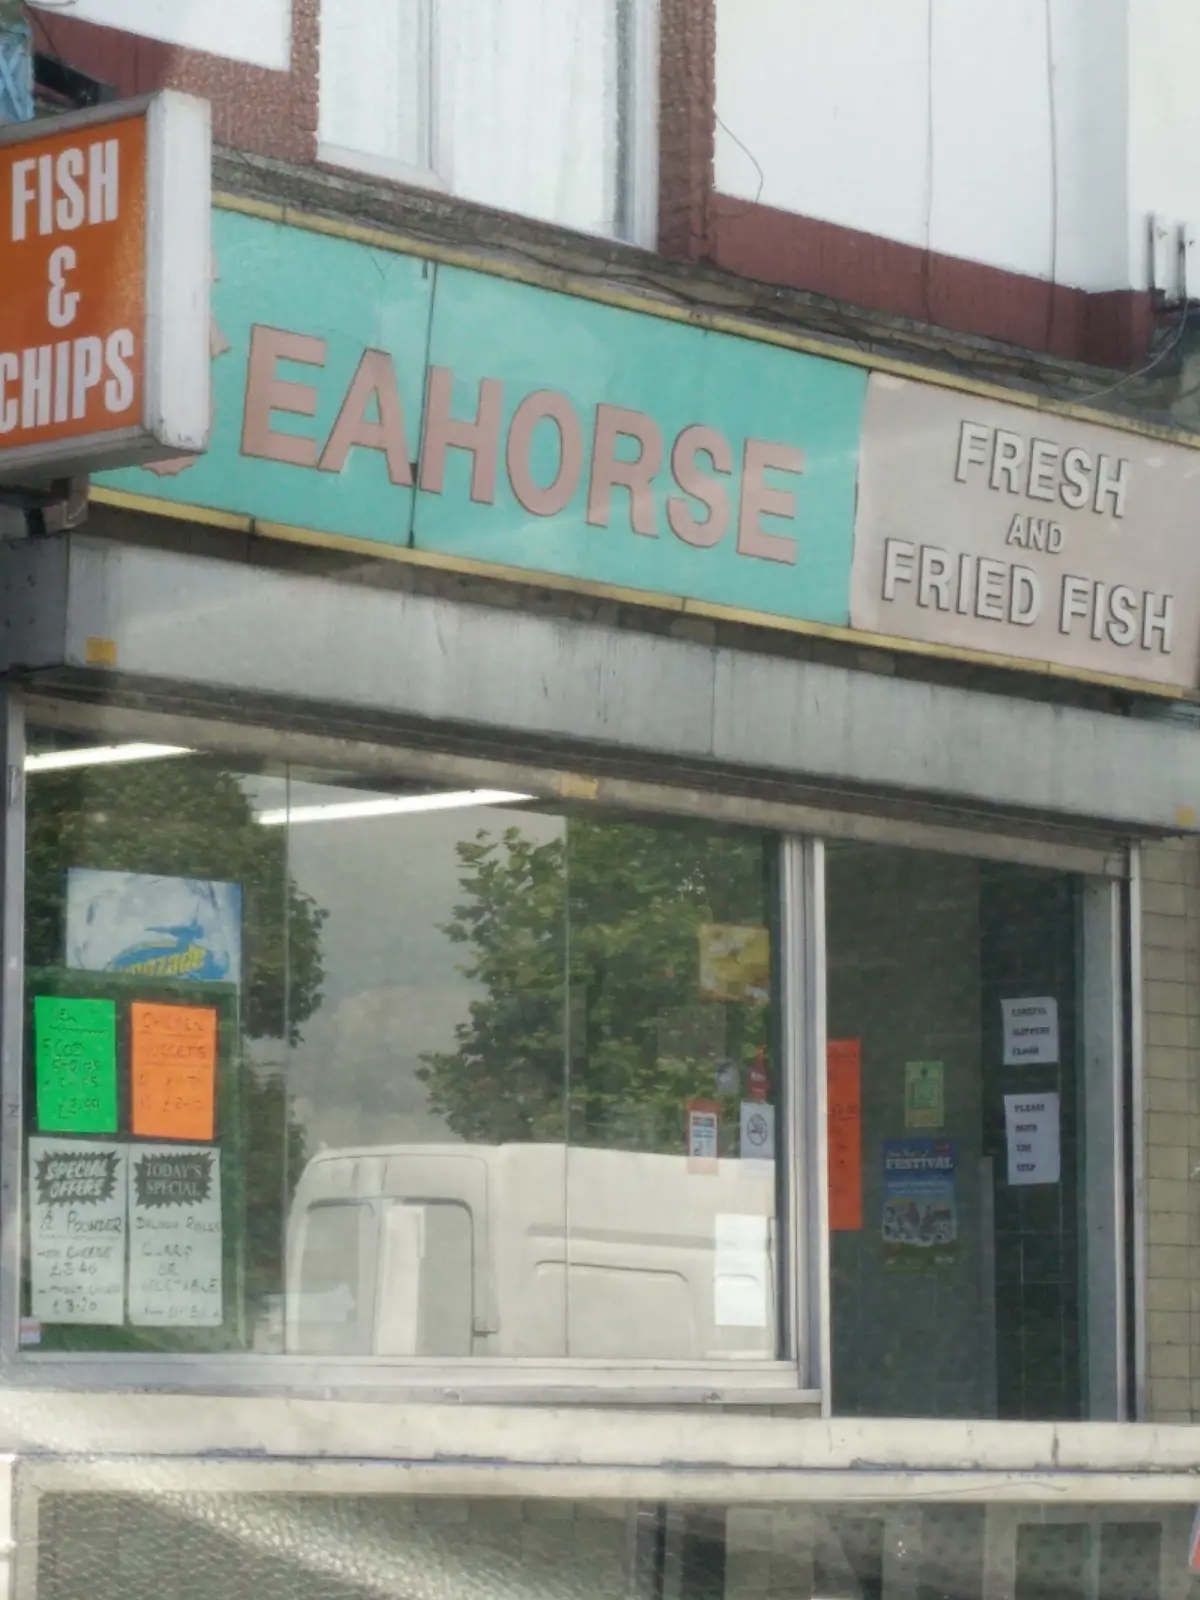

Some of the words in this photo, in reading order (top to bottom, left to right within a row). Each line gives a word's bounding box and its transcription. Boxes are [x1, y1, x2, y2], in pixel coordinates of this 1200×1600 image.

[11, 139, 119, 241] FISH
[47, 246, 80, 328] &
[0, 328, 134, 434] CHIPS
[205, 300, 805, 566] EAHORSE
[954, 419, 1131, 518] FRESH
[1005, 513, 1067, 554] AND
[881, 537, 1043, 627] FRIED
[1058, 573, 1174, 654] FISH
[45, 1159, 109, 1181] SPECIAL
[50, 1179, 104, 1198] OFFERS
[145, 1162, 203, 1179] TODAY'S
[145, 1180, 201, 1197] SPECIAL
[886, 1156, 954, 1171] FESTIVAL
